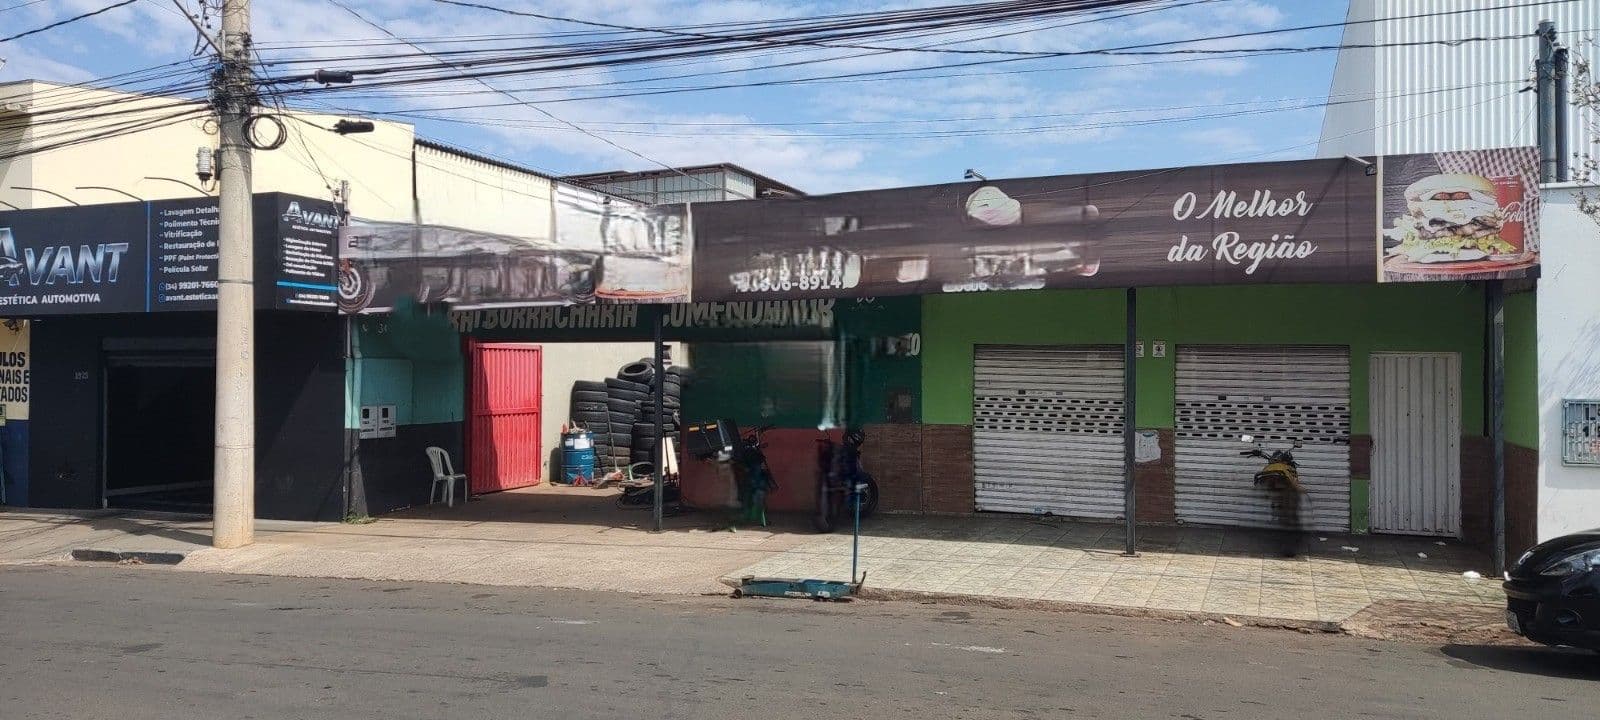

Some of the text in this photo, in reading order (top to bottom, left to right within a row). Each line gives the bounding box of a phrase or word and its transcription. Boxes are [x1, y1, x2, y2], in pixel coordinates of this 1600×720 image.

[1172, 189, 1314, 221] O Melhor
[164, 207, 194, 216] Lavagem
[164, 220, 198, 228] Polimento
[164, 229, 203, 239] Vitrificação
[164, 240, 216, 250] Restauração de
[164, 254, 177, 262] PPF
[1167, 231, 1318, 275] da Região
[190, 264, 208, 273] Solar
[41, 293, 101, 304] AUTOMOTIVA
[24, 370, 30, 384] E
[0, 386, 28, 402] ADOS
